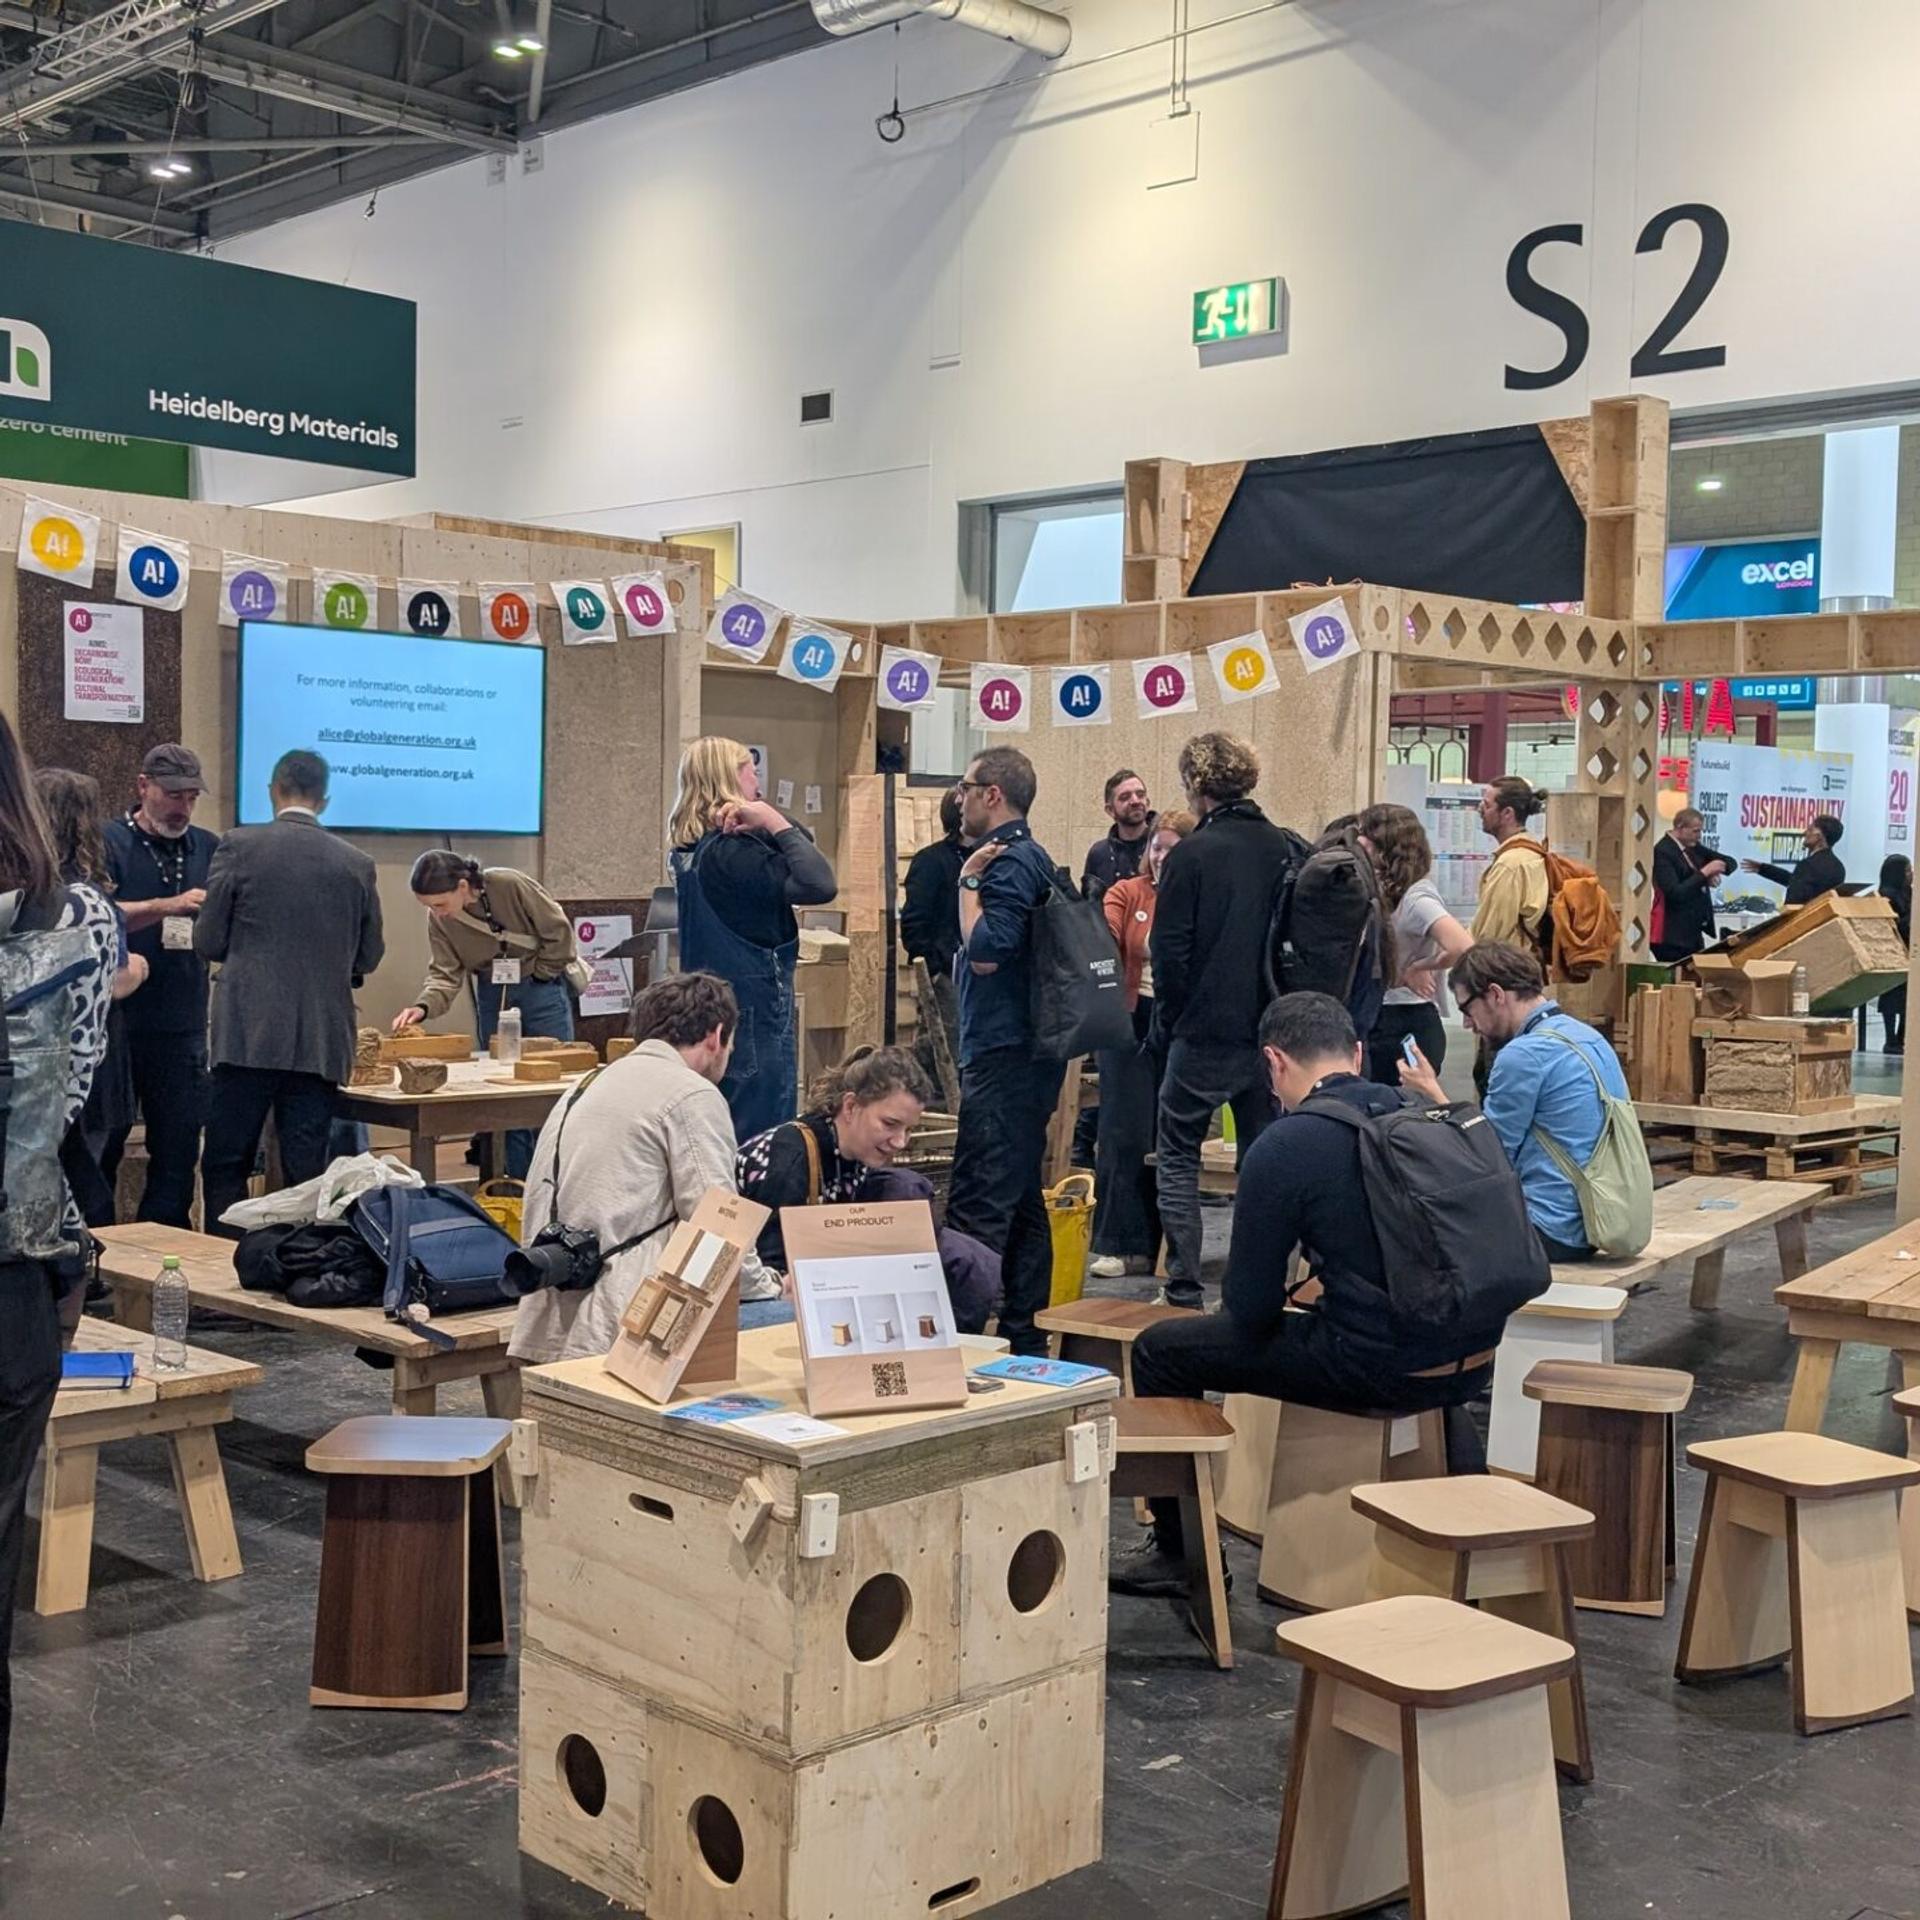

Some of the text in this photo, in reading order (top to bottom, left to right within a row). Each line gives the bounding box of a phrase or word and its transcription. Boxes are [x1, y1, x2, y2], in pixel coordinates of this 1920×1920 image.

[149, 388, 399, 448] Heidelberg Materials
[45, 531, 70, 558] A!
[142, 559, 166, 585] A!
[1741, 553, 1815, 585] excel
[1776, 580, 1813, 589] LONDON
[242, 584, 263, 609] A!
[336, 596, 356, 619] A!
[577, 598, 596, 618] A!
[635, 594, 656, 616] A!
[74, 613, 87, 627] A!
[419, 604, 439, 626] A!
[501, 605, 520, 628] A!
[731, 614, 756, 638] A!
[1315, 625, 1336, 649] A!
[801, 646, 824, 669] A!
[1235, 657, 1255, 681] A!
[297, 673, 497, 699] For more information, collaborations or
[897, 671, 919, 692] A!
[1156, 675, 1175, 698] A!
[350, 697, 448, 713] volunteering email:
[991, 690, 1010, 711] A!
[1070, 685, 1090, 707] A!
[318, 728, 476, 751] alice@globalgeneration.org.uk
[329, 763, 475, 782] ww.globalgeneration.org.uk
[1700, 759, 1731, 771] futurebuild
[1699, 791, 1728, 814] COLLECT
[1889, 769, 1909, 813] 20
[1701, 814, 1718, 835] OUR
[1774, 836, 1810, 862] IMPAC
[824, 1216, 894, 1228] END PRODUCT
